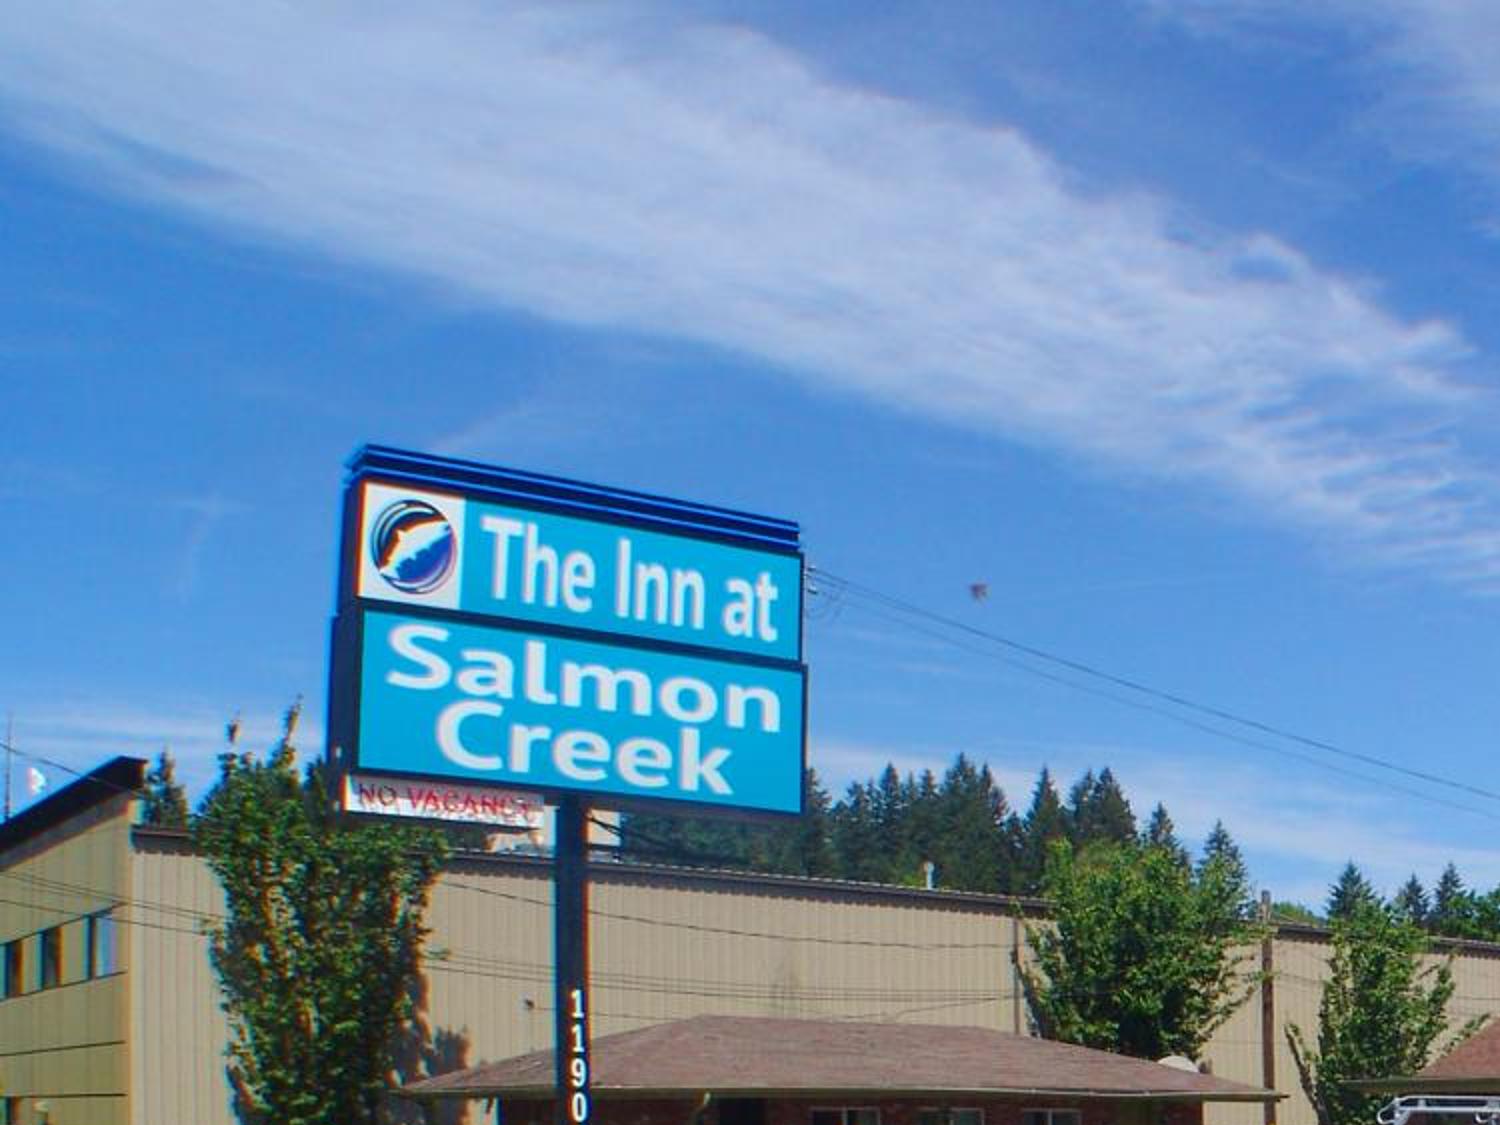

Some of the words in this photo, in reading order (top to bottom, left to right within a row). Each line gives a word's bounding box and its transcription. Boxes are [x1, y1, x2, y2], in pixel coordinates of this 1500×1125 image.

[481, 515, 596, 613] The
[615, 538, 704, 630] Inn
[723, 571, 778, 643] at
[387, 624, 781, 732] Salmon
[358, 783, 397, 807] NO
[436, 699, 733, 796] Creek
